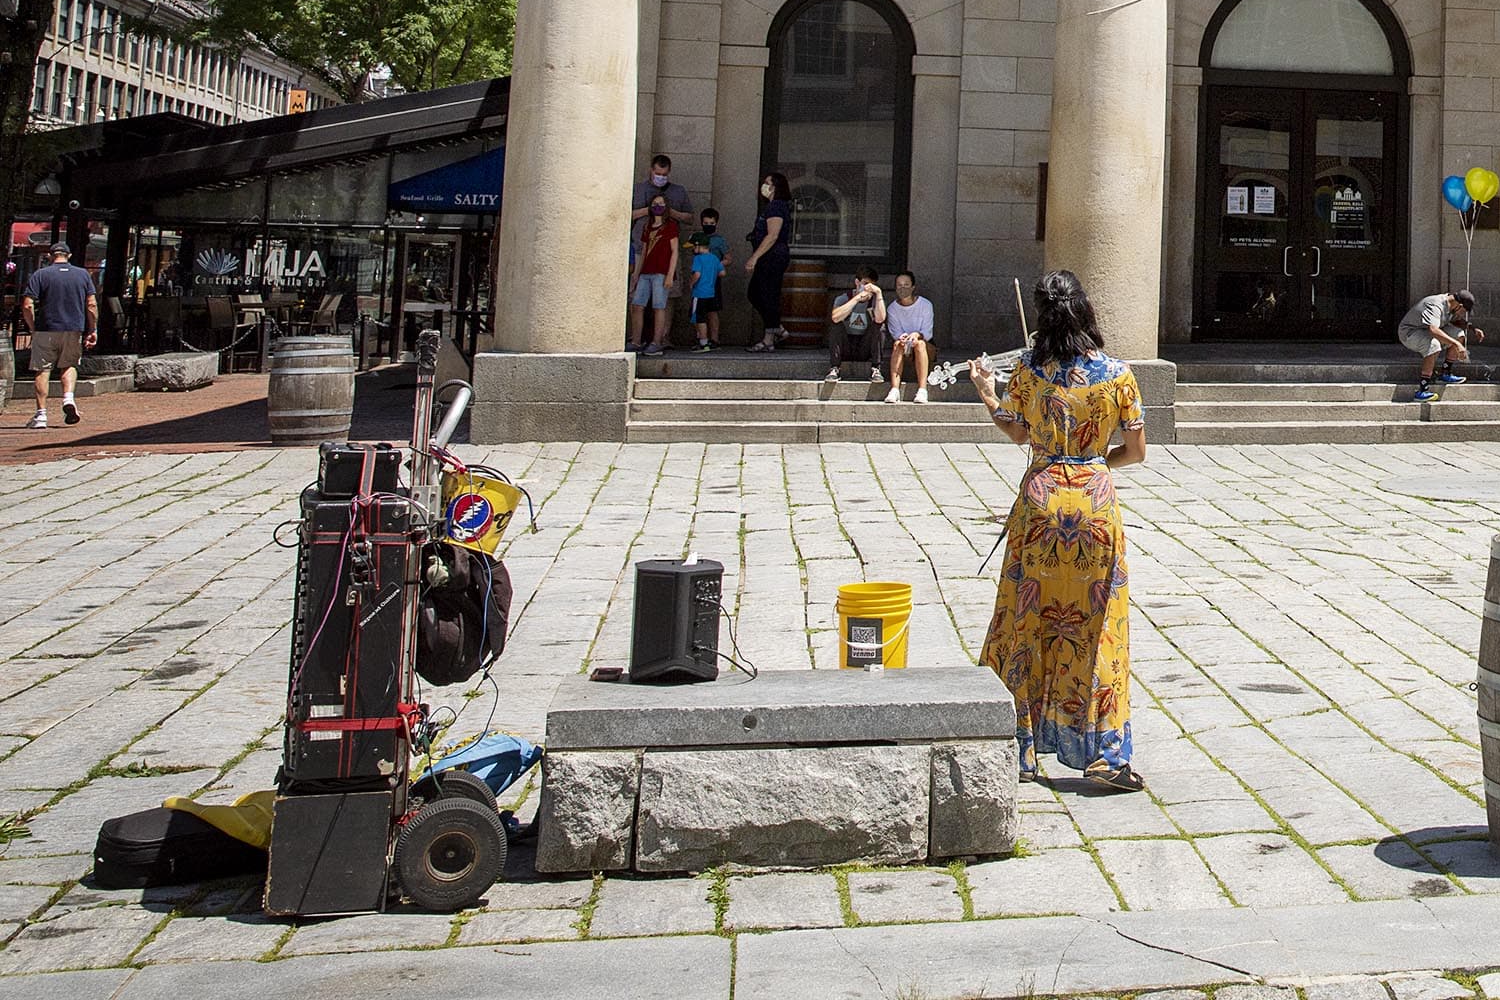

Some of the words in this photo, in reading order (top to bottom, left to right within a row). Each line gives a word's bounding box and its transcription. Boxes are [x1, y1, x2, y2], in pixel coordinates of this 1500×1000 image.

[454, 193, 499, 206] SALTY
[194, 274, 238, 285] Cantina
[244, 275, 253, 286] &
[307, 278, 327, 288] Bar
